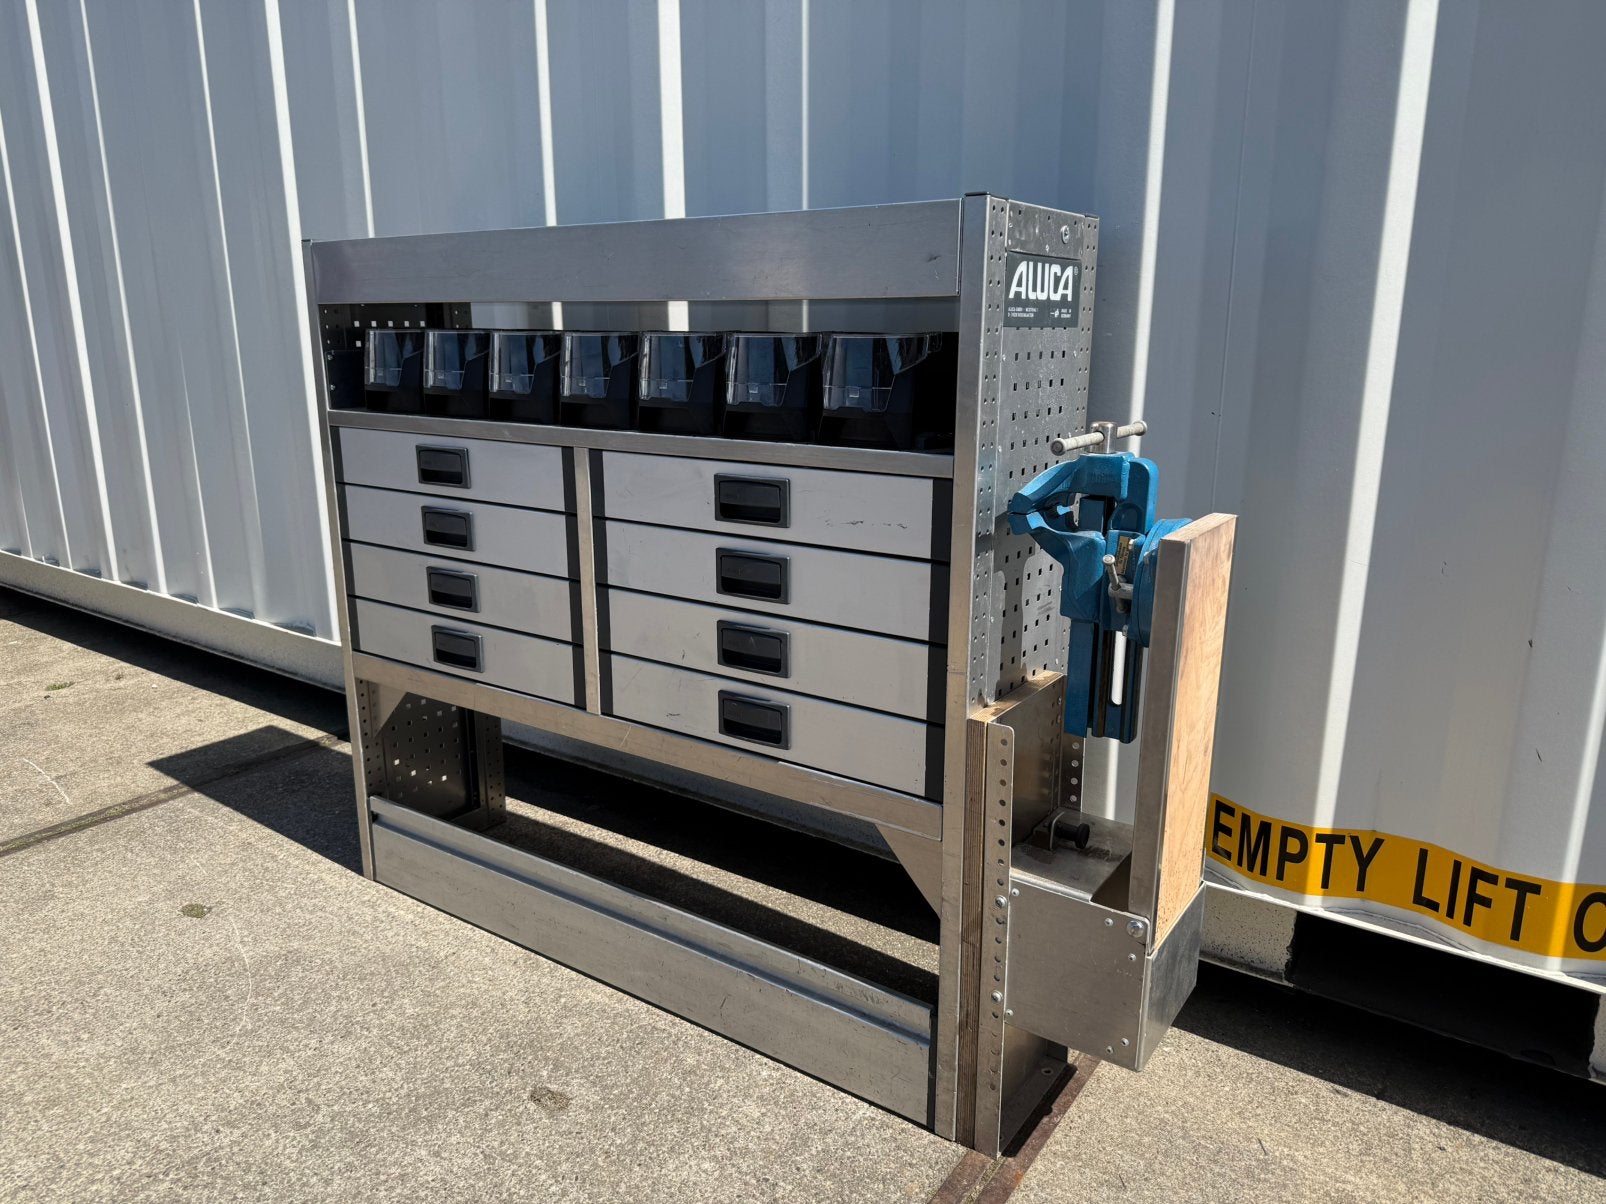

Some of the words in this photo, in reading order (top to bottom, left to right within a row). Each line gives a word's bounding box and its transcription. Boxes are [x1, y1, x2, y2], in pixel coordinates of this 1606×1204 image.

[1008, 261, 1074, 302] ALUCA
[1211, 799, 1385, 892] EMPTY
[1412, 848, 1542, 942] LIFT
